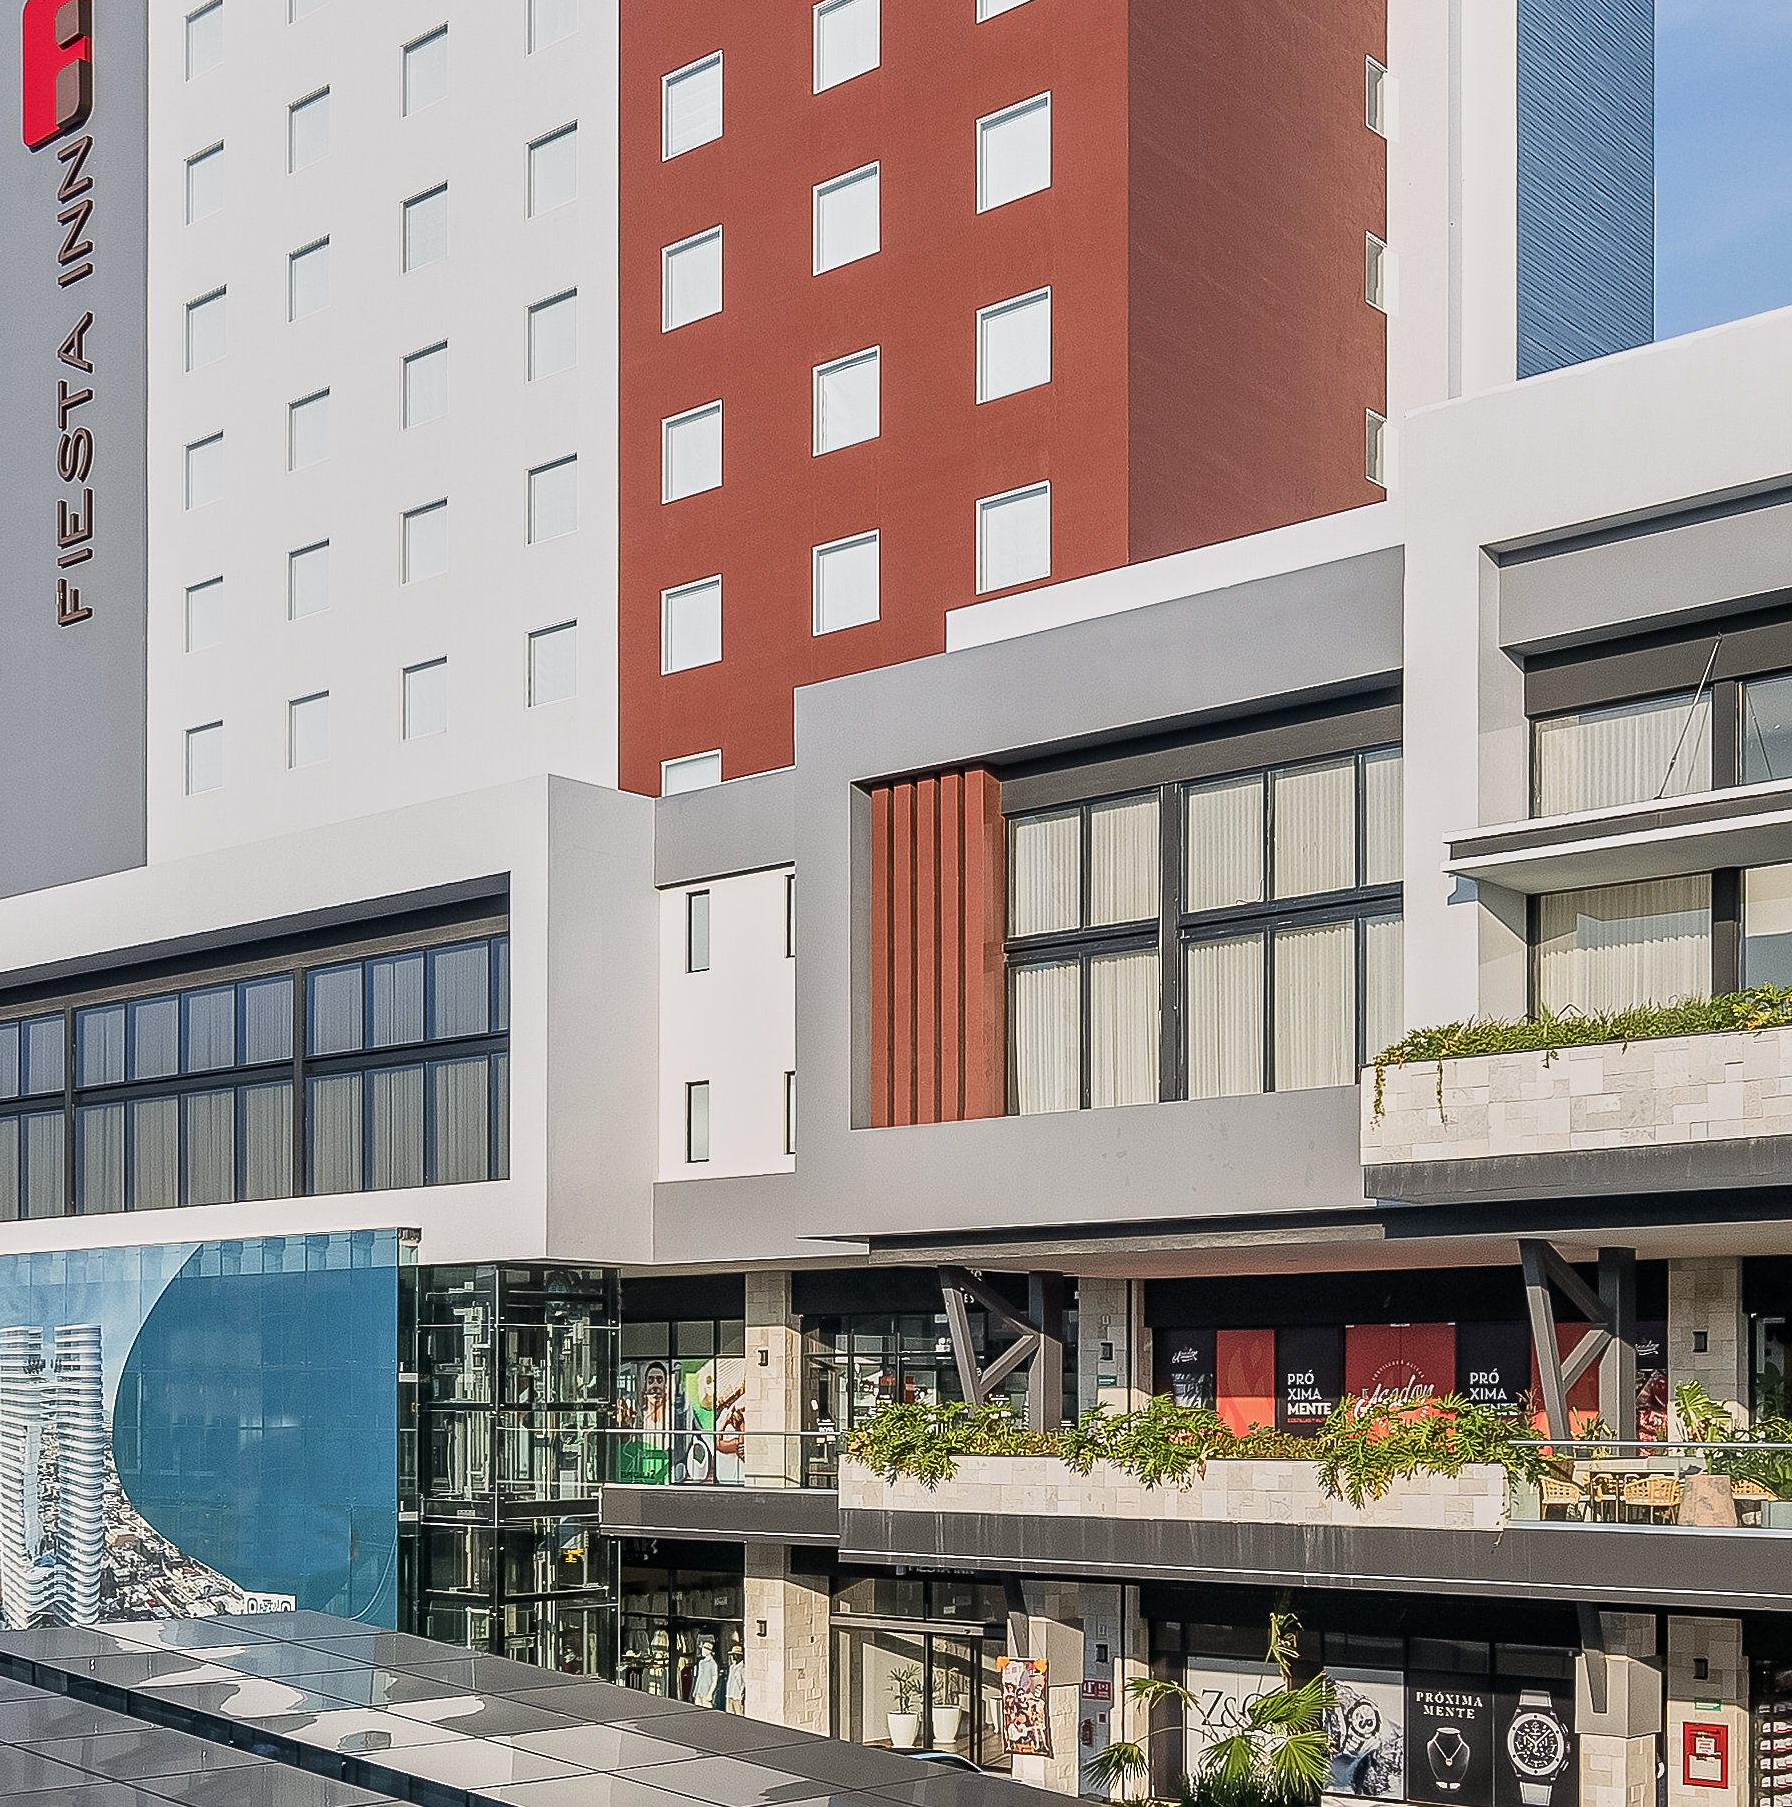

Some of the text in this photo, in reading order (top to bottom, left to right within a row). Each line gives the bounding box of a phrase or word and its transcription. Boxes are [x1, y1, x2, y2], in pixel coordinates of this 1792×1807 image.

[57, 135, 95, 629] FIESTA INN
[1287, 1369, 1315, 1385] PRÓ
[1469, 1367, 1500, 1384] PRÓ
[1287, 1387, 1323, 1401] XIMA
[1469, 1387, 1508, 1401] XIMA
[1287, 1402, 1332, 1415] MENTE
[1415, 1691, 1484, 1708] PRÓXIMA
[1422, 1704, 1476, 1720] MENTE
